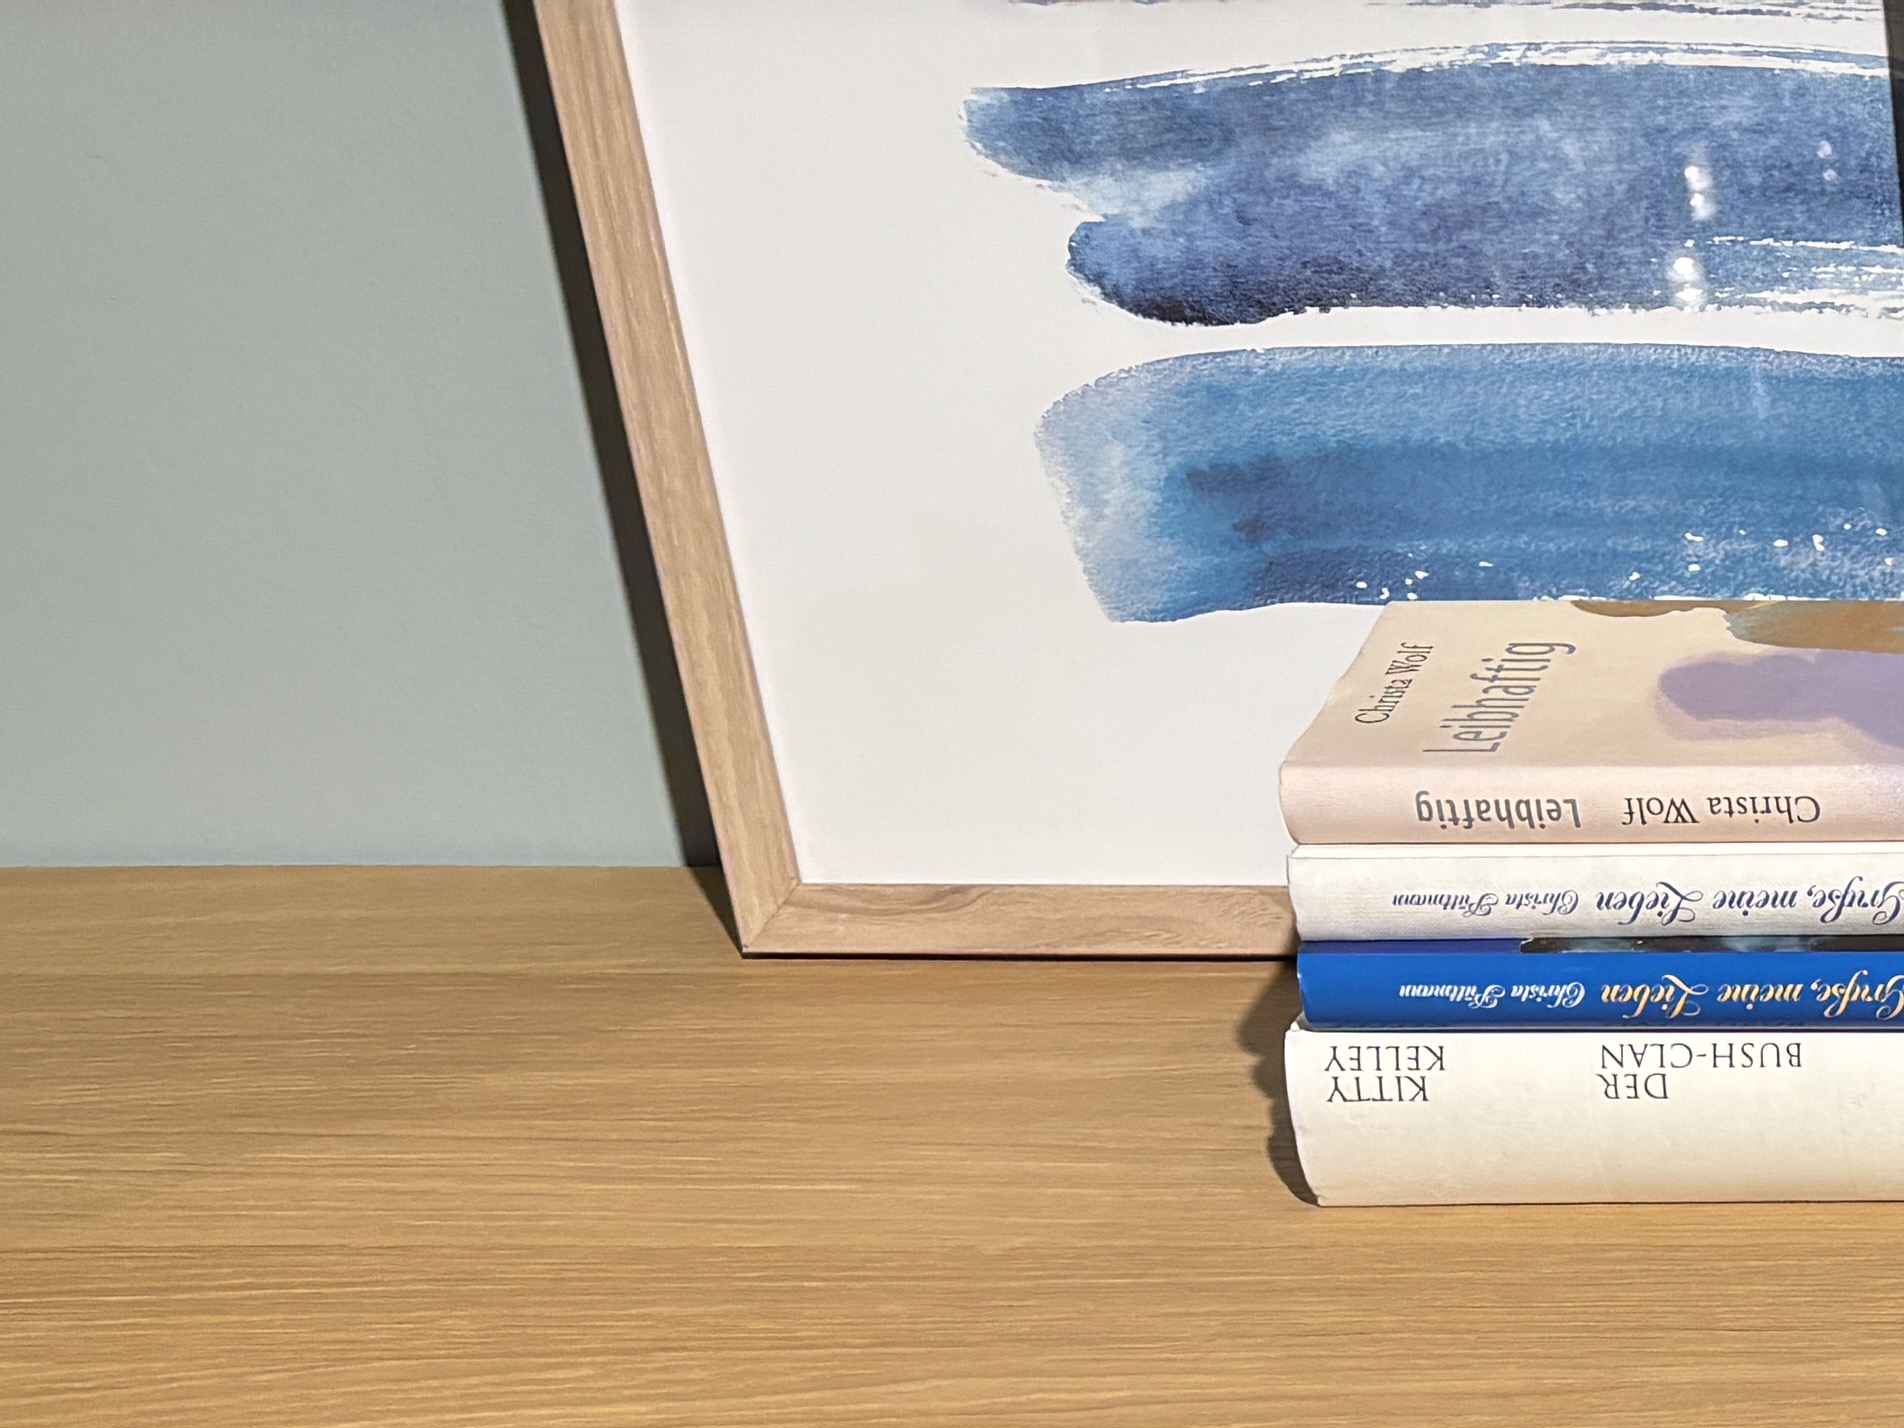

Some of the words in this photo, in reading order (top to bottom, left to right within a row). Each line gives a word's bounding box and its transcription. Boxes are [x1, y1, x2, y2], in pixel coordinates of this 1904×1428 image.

[1354, 671, 1414, 725] Christa
[1385, 641, 1435, 678] Wolf
[1422, 640, 1578, 754] Leibhaftig
[1414, 789, 1582, 831] Leibhaftig
[1620, 795, 1700, 827] Wolf
[1705, 793, 1822, 826] Christa
[1391, 891, 1499, 918] Püttmann
[1505, 890, 1579, 916] Christa
[1596, 881, 1704, 926] Lieben
[1711, 889, 1799, 917] meine
[1398, 983, 1506, 1010] Püttmann
[1511, 981, 1587, 1009] Christa
[1601, 974, 1709, 1021] Lieben
[1717, 982, 1804, 1011] meine
[1323, 1044, 1446, 1072] KELLEY
[1600, 1041, 1803, 1069] BUSH-CLAN
[1326, 1075, 1430, 1103] KITTY
[1597, 1072, 1669, 1101] DER
